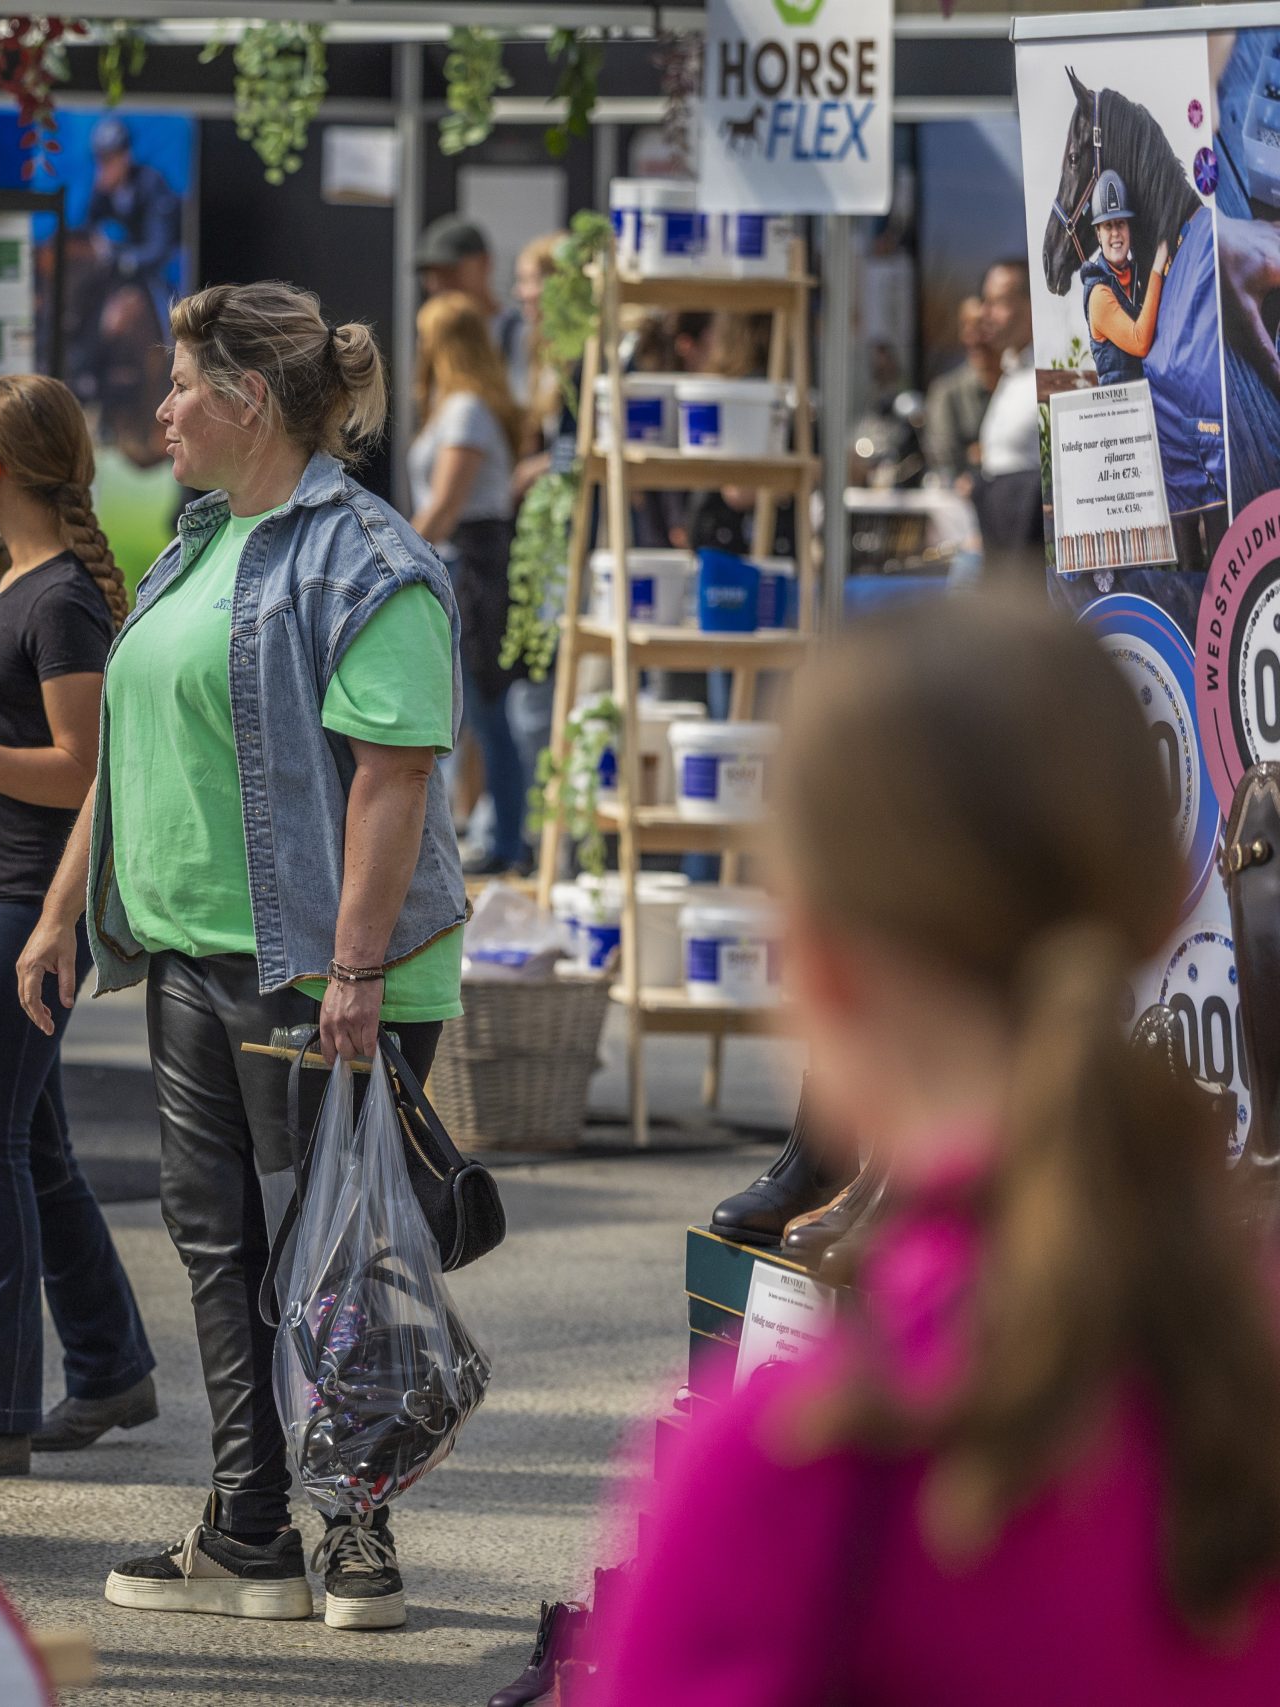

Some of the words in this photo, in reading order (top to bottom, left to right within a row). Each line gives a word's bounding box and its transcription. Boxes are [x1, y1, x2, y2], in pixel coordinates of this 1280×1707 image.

[720, 38, 876, 97] HORSE
[766, 100, 875, 162] FLEX
[1061, 441, 1083, 453] Volledig
[1083, 440, 1099, 449] naar
[1099, 437, 1118, 449] eigen
[1119, 436, 1134, 446] wens
[1104, 452, 1136, 465] rijlaarzen
[1097, 469, 1121, 482] All-in
[1206, 514, 1280, 692] WEDSTRIJDN
